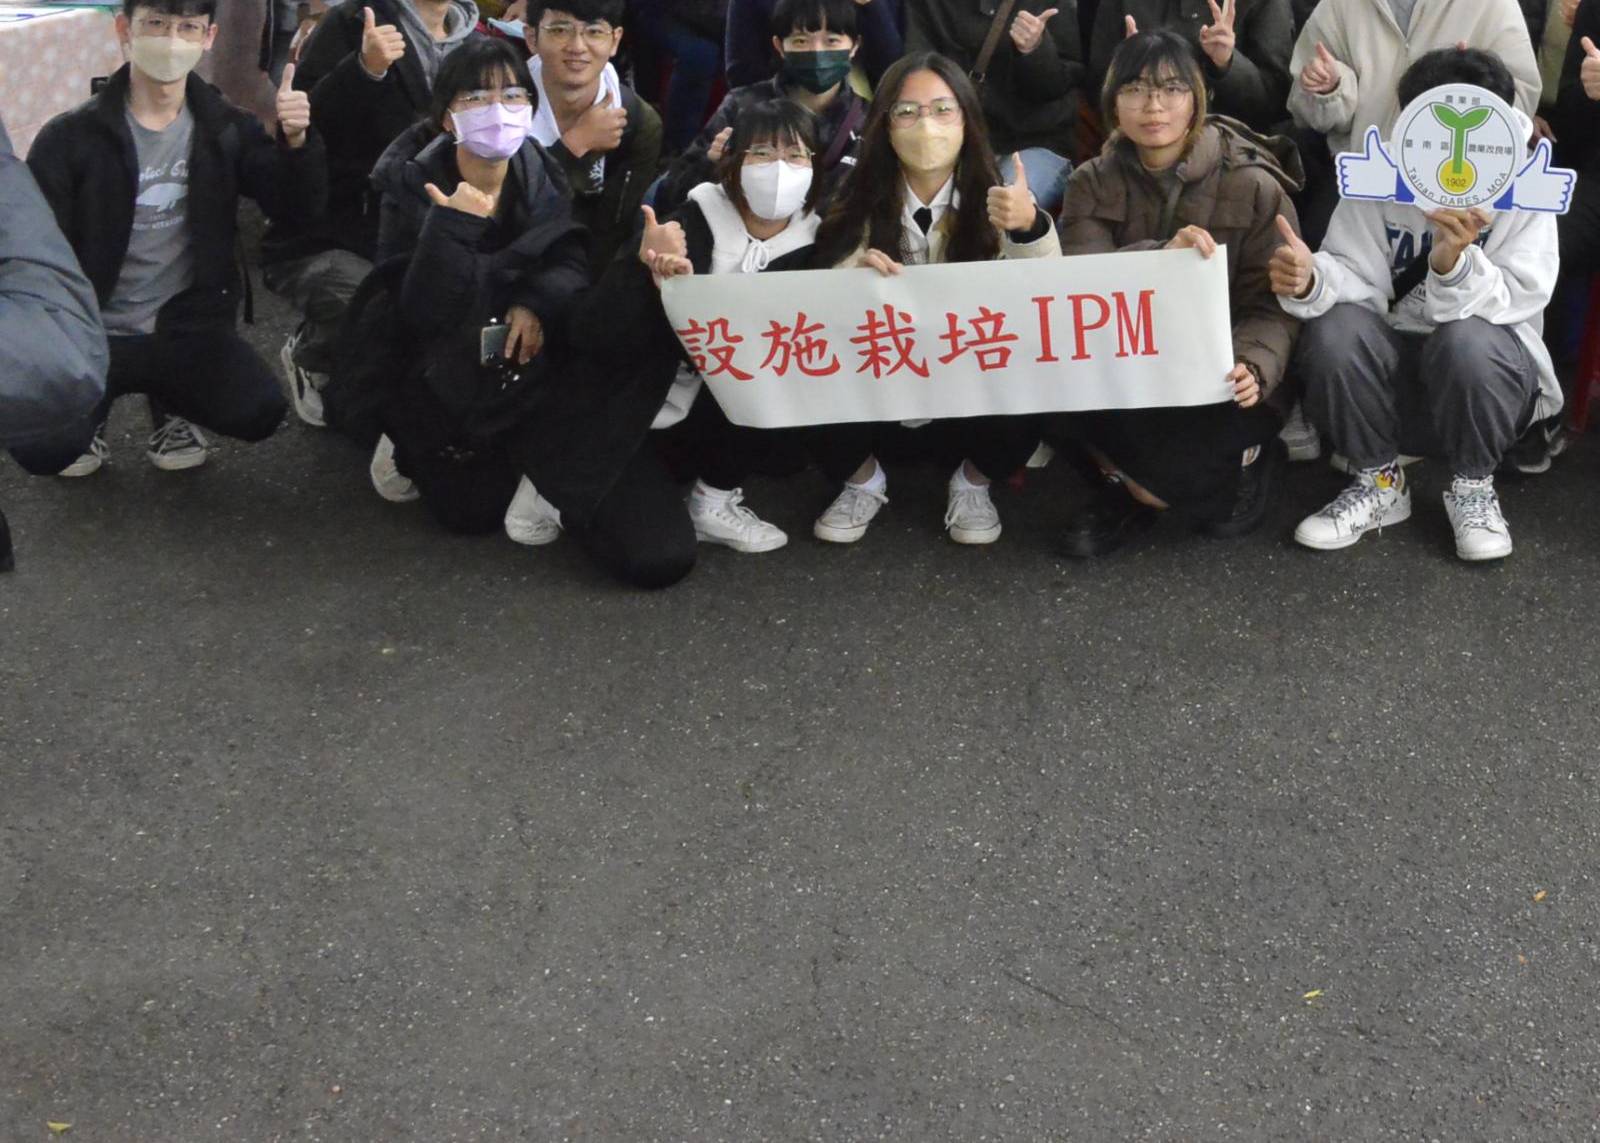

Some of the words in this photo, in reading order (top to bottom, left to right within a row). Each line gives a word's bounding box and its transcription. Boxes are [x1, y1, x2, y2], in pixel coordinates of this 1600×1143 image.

[1445, 95, 1480, 105] 農業部
[1468, 144, 1513, 155] 農業改良場
[1408, 167, 1436, 200] Tainan
[1487, 172, 1508, 195] MOA
[1446, 178, 1466, 188] 1902
[677, 289, 1159, 381] 設施栽培IPM
